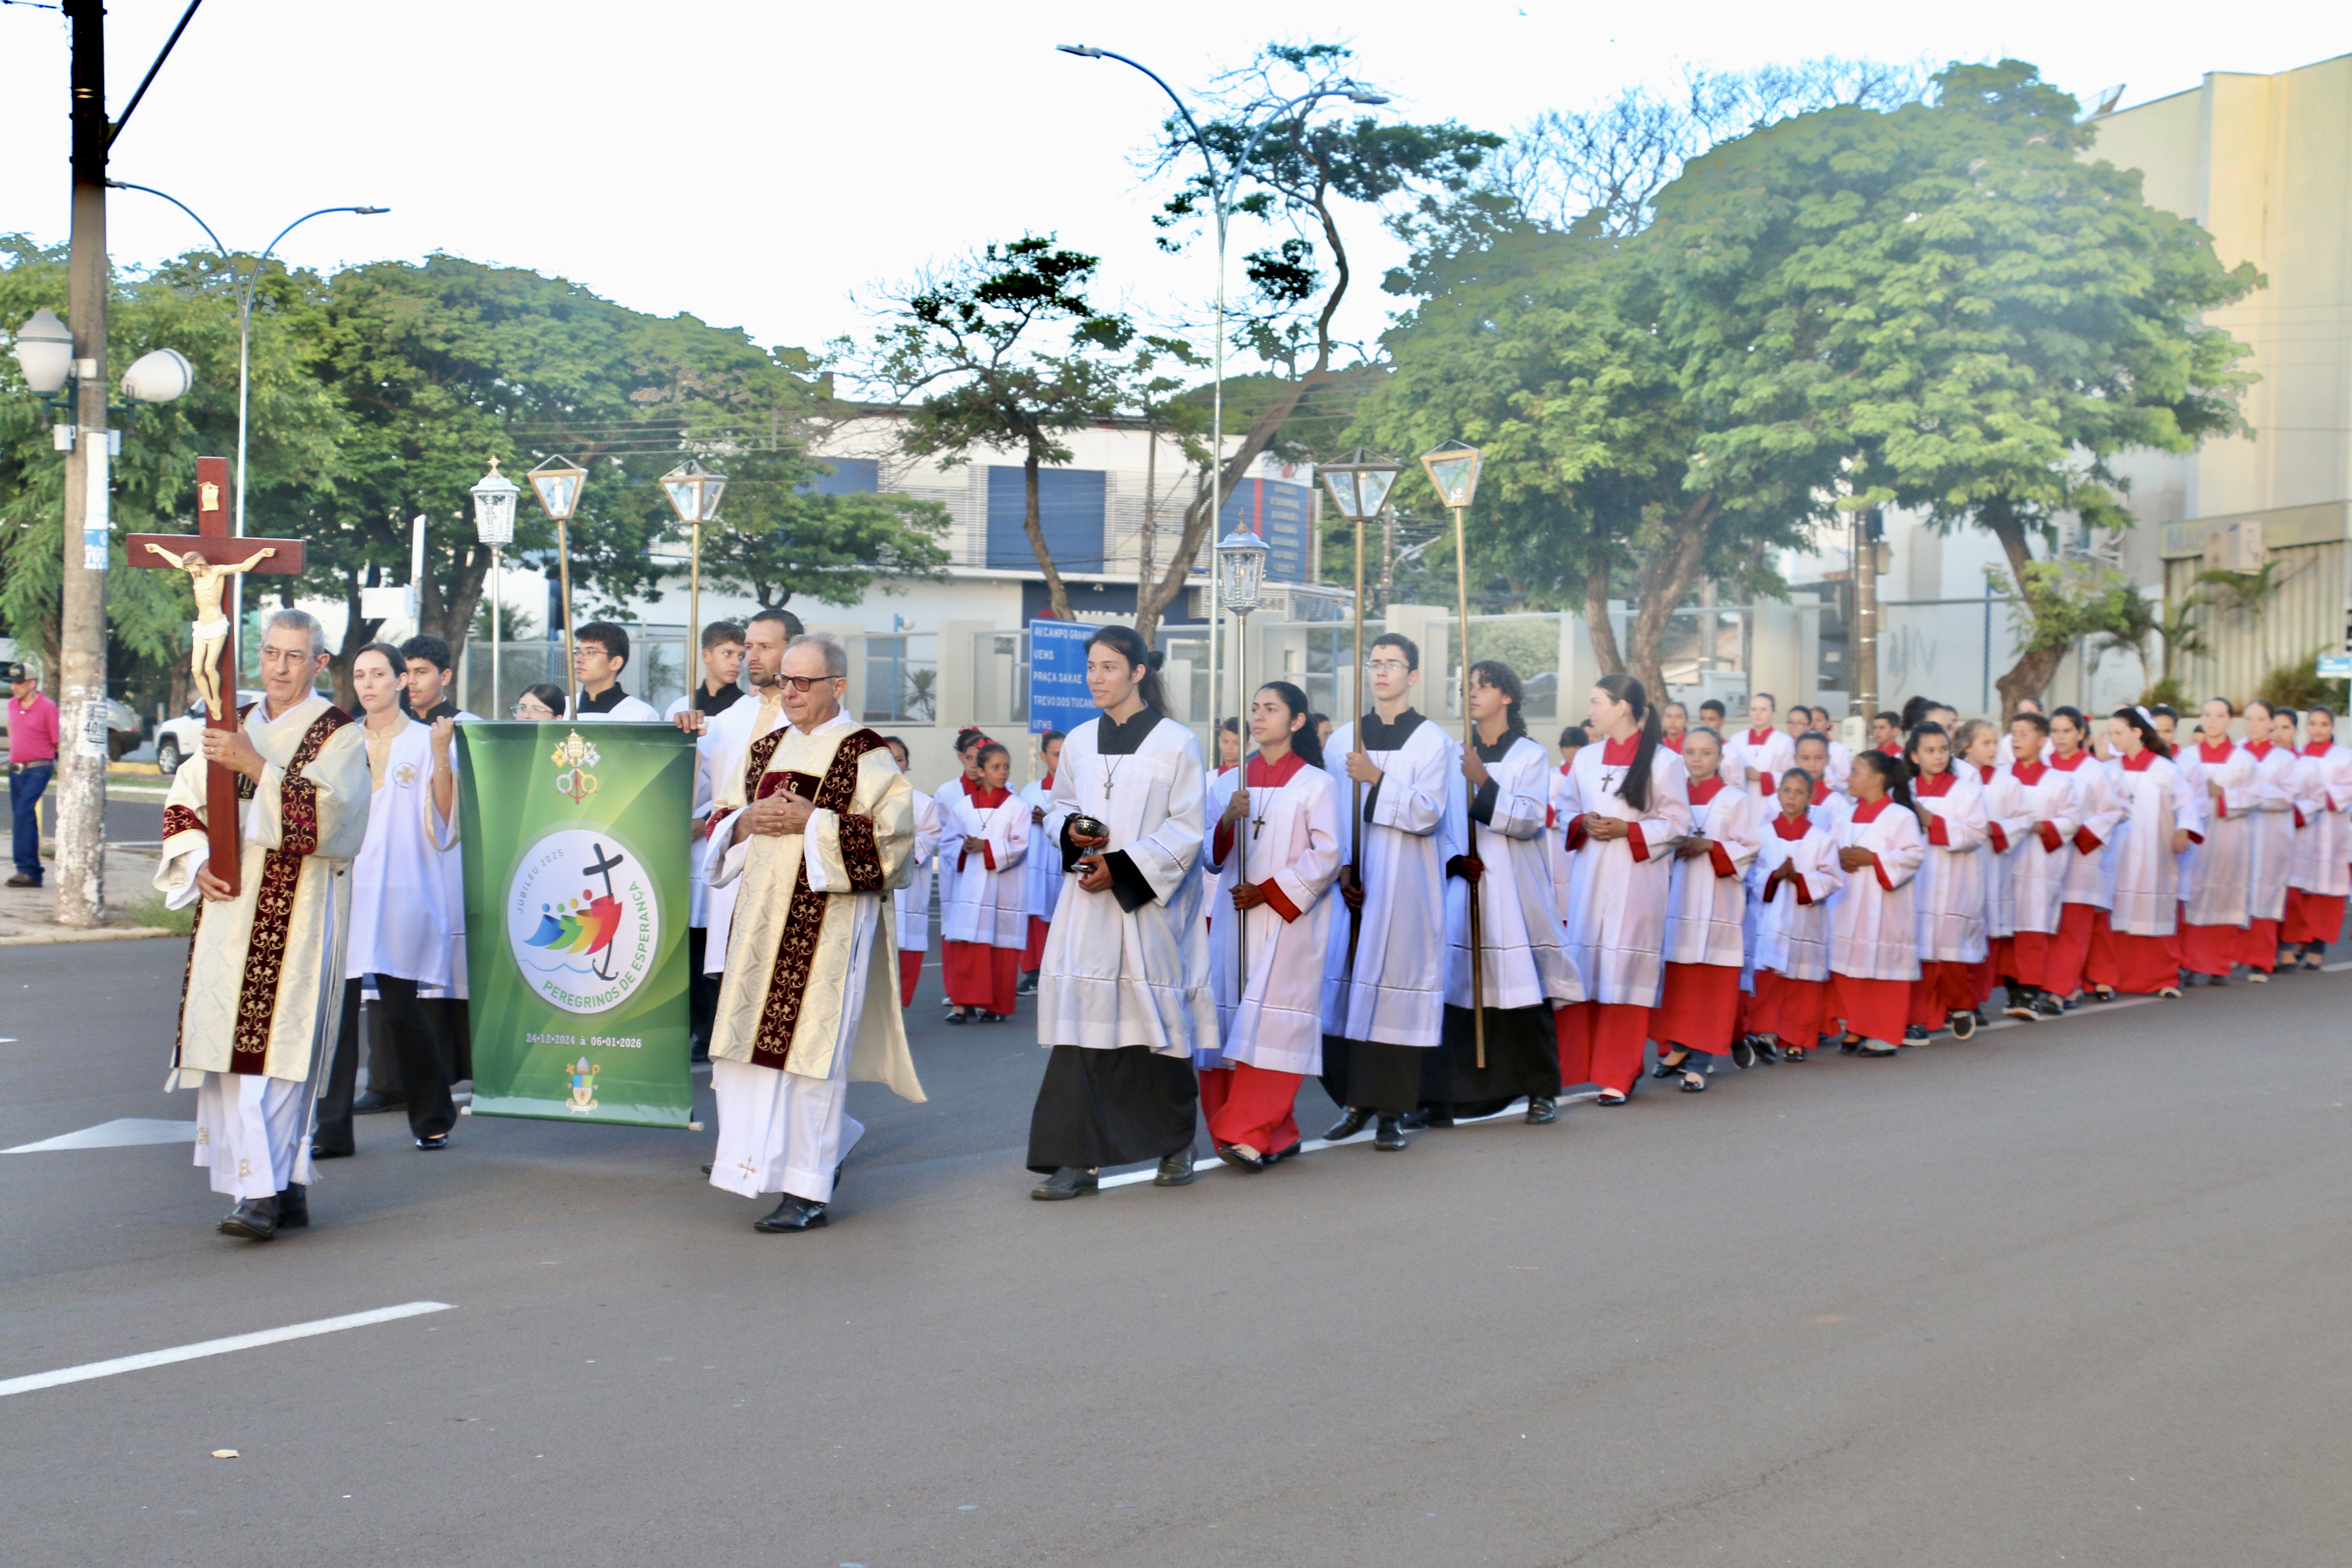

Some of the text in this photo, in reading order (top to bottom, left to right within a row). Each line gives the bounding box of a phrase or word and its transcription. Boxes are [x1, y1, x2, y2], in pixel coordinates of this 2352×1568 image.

[1043, 627, 1069, 639] CAMPO
[1033, 649, 1054, 660] UEMS
[1033, 671, 1083, 684] PRAÇA SAKAE
[1033, 695, 1056, 706] TREVO
[1056, 696, 1070, 707] DOS
[1032, 719, 1052, 730] UFMS
[517, 848, 564, 914] JUBILEU 2025
[542, 879, 650, 1008] PEREGRINOS DE ESPERANÇA
[579, 1036, 586, 1046] à
